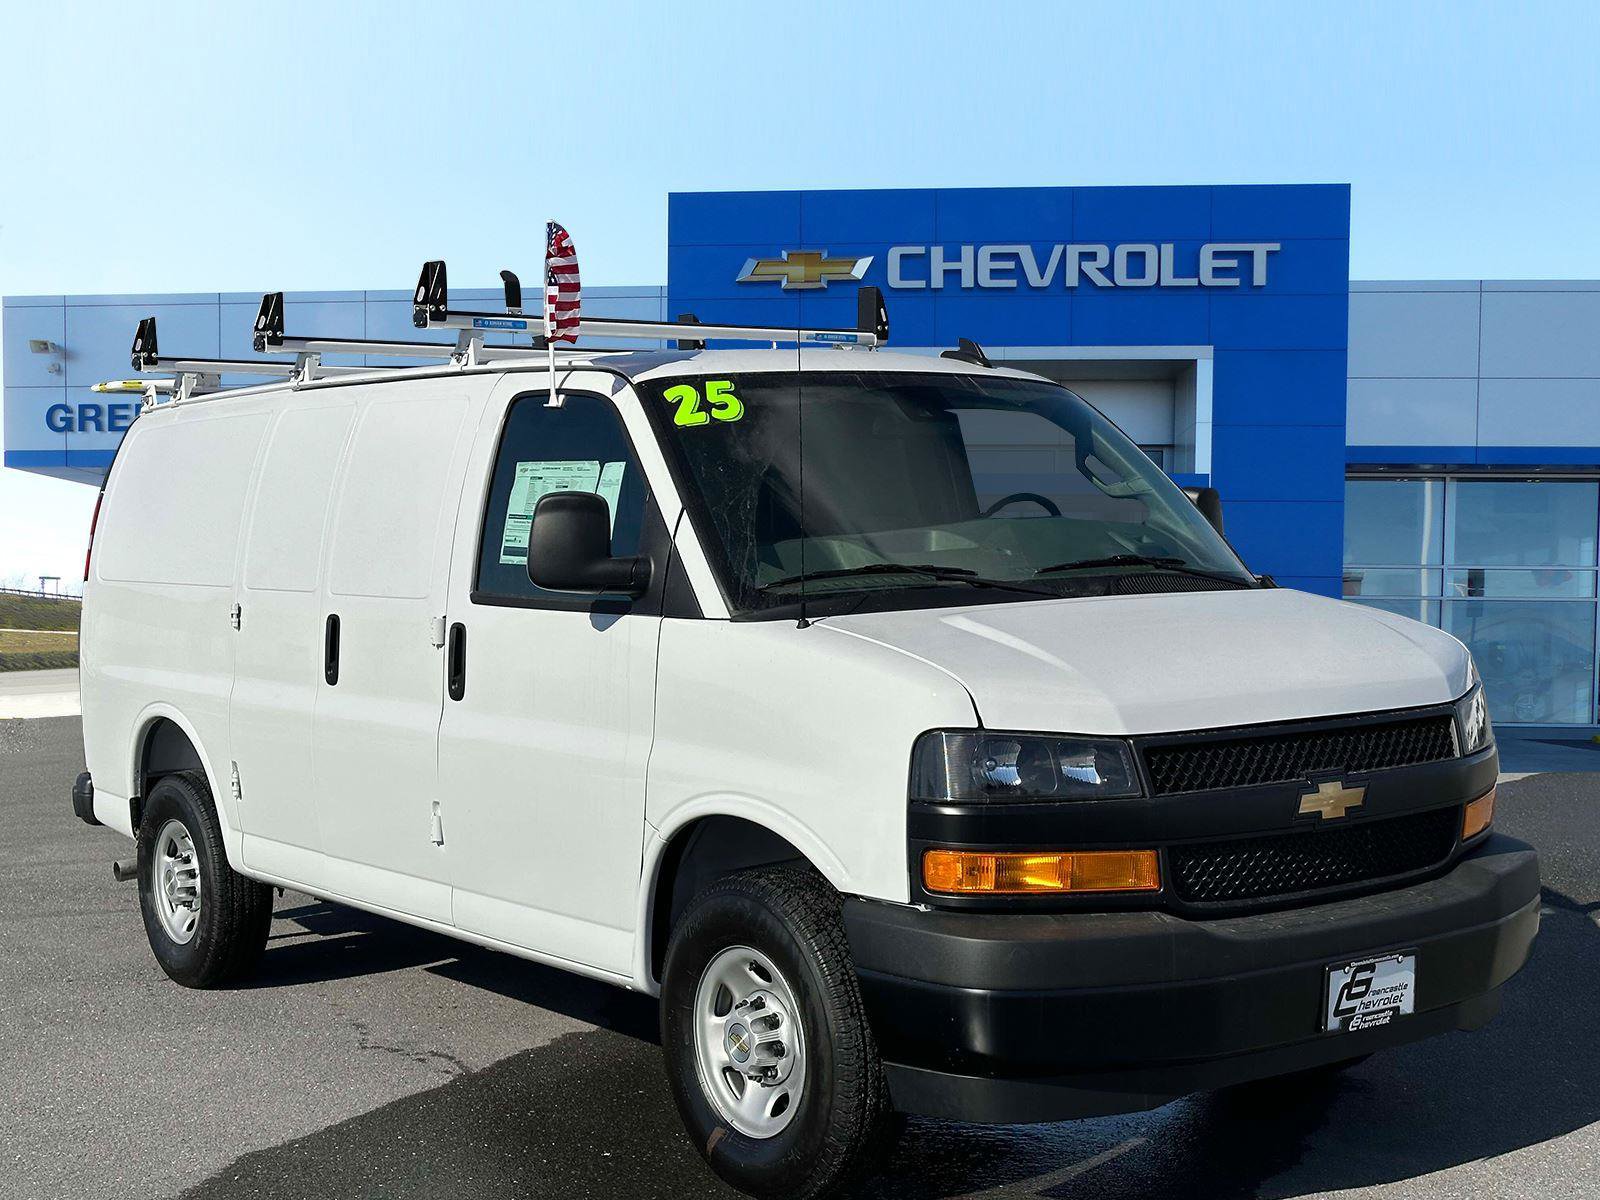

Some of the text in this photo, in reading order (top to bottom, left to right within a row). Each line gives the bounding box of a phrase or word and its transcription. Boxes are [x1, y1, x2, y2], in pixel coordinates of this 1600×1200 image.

[887, 243, 1281, 289] CHEVROLET
[46, 403, 141, 433] GRE
[663, 381, 744, 426] 25
[1333, 981, 1404, 1018] Chevrolet
